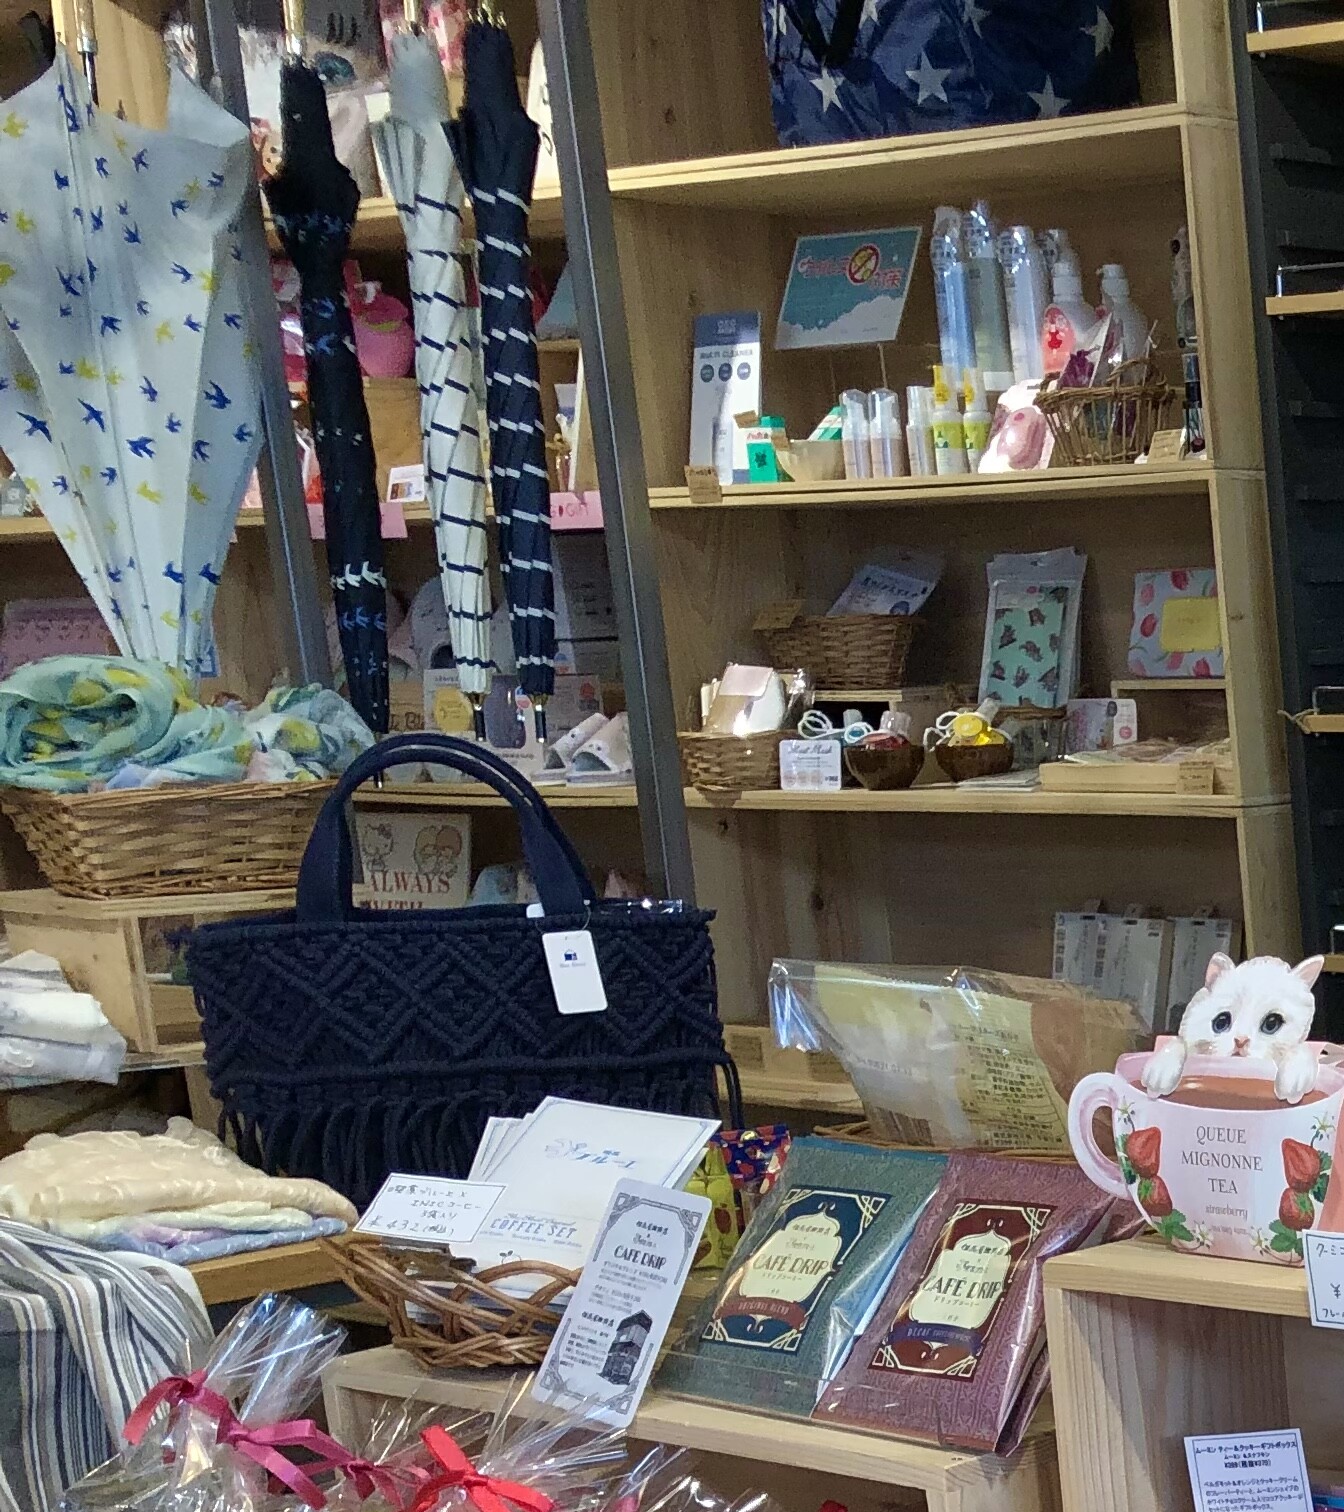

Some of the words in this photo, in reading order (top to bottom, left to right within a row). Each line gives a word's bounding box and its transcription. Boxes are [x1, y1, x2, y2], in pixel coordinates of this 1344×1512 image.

[1196, 1125, 1247, 1146] QUEUE
[1181, 1151, 1264, 1172] MIGNONNE
[1208, 1177, 1238, 1195] TEA
[547, 1225, 578, 1240] SET
[791, 1256, 830, 1276] DRIP
[966, 1280, 1002, 1300] DRIP
